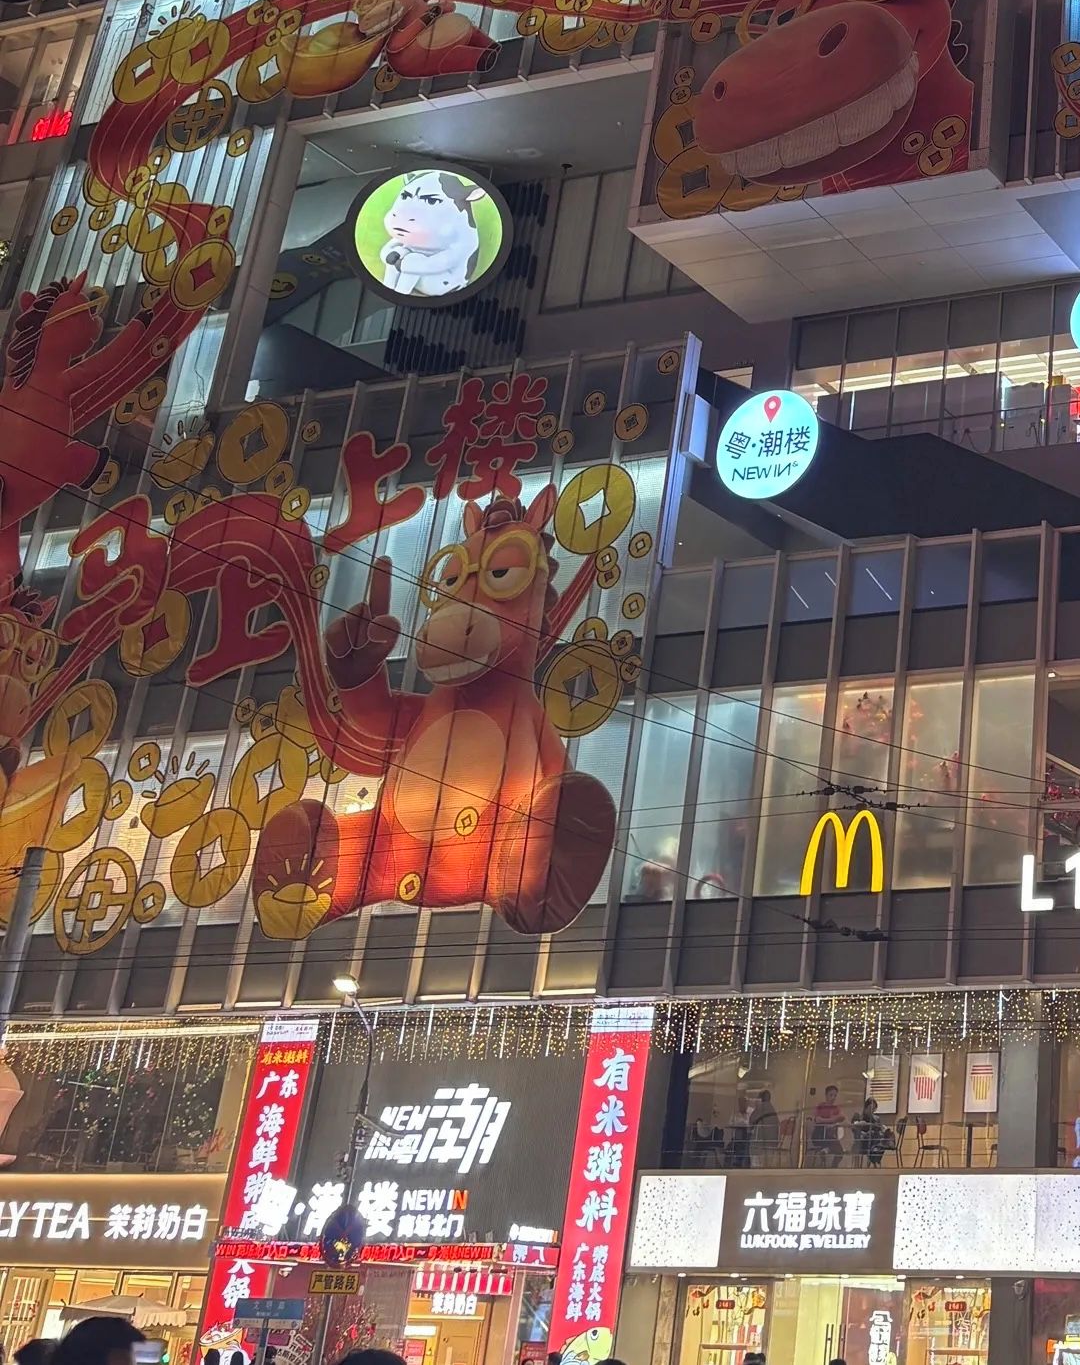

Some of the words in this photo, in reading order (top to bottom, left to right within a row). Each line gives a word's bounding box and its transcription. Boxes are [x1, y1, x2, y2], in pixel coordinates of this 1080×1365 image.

[731, 464, 772, 482] NEW
[256, 1069, 299, 1099] 广东
[576, 1047, 635, 1234] 有米粥料
[402, 1189, 446, 1211] NEW
[447, 1189, 469, 1211] IN
[742, 1191, 875, 1233] 六福珠寶
[104, 1203, 208, 1241] 茉莉奶白
[740, 1234, 799, 1249] LUKFOOK
[799, 1234, 871, 1250] JEWELLERY
[311, 1274, 356, 1291] 严管路段
[565, 1242, 590, 1322] 广东海鲜
[585, 1245, 609, 1322] 粥底火锅
